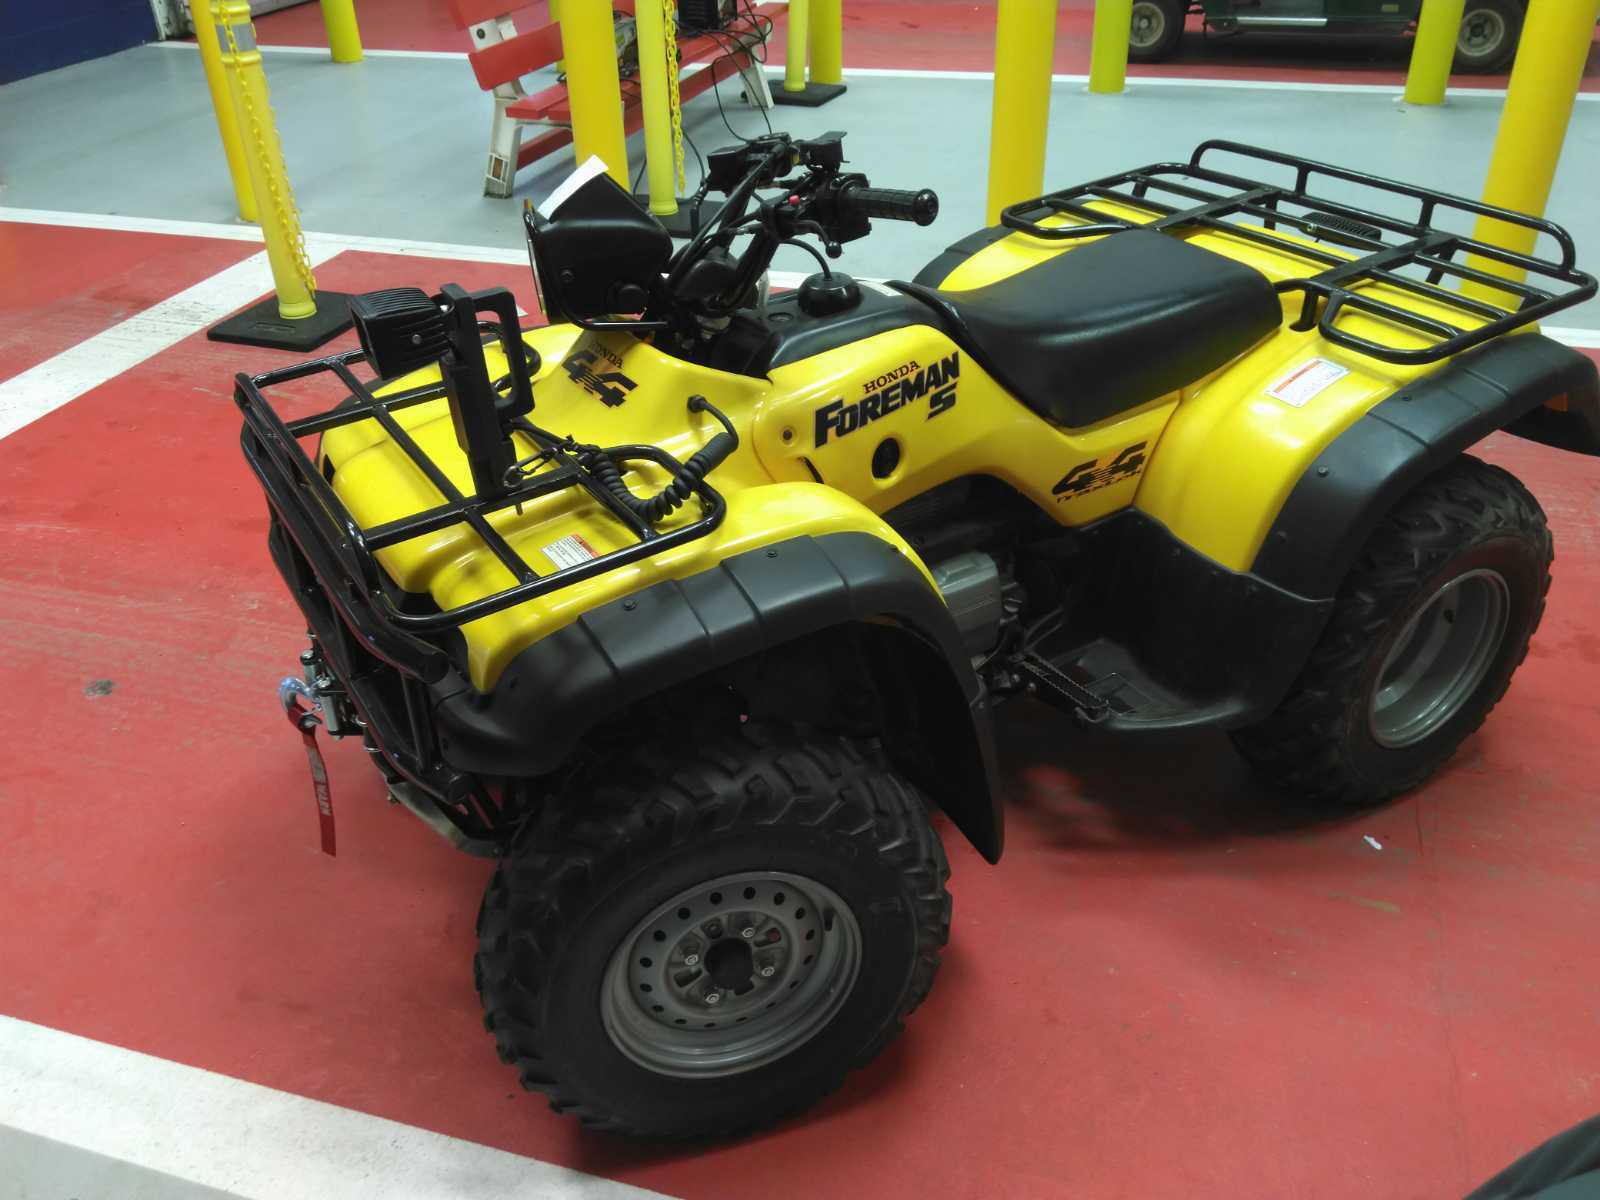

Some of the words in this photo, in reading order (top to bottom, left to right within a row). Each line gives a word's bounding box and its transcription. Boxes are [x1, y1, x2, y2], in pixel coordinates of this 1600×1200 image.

[586, 342, 623, 370] ONDA
[863, 360, 920, 394] HONDA
[815, 351, 960, 448] FOREMAN
[928, 382, 957, 420] S
